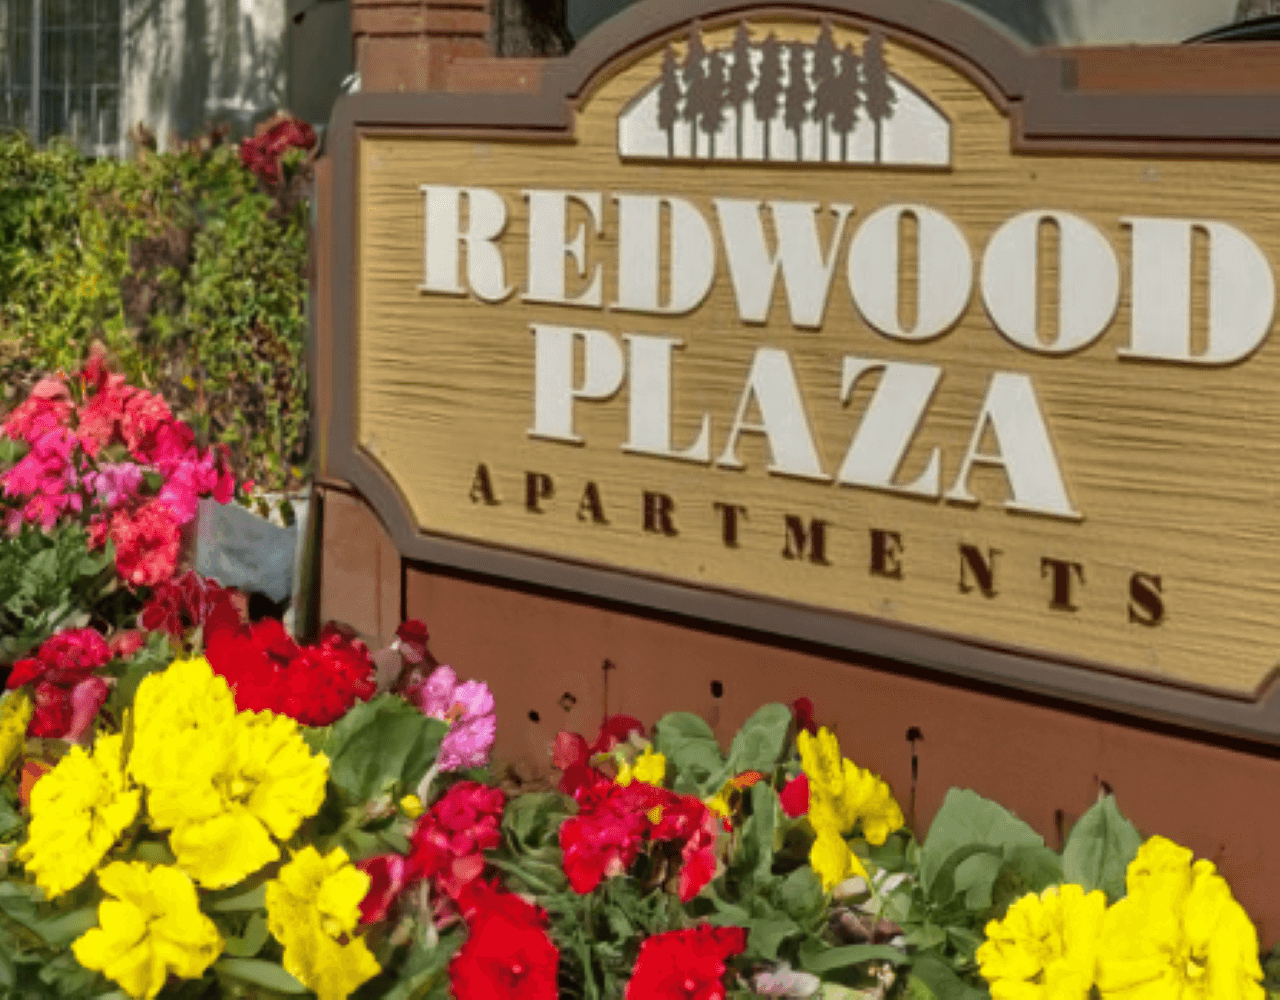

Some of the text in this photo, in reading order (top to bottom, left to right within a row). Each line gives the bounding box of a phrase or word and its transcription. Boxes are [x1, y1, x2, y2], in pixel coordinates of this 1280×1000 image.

[418, 184, 1277, 366] REDWOOD
[528, 323, 1084, 522] PLAZA
[468, 463, 1167, 627] APARTMENTS
